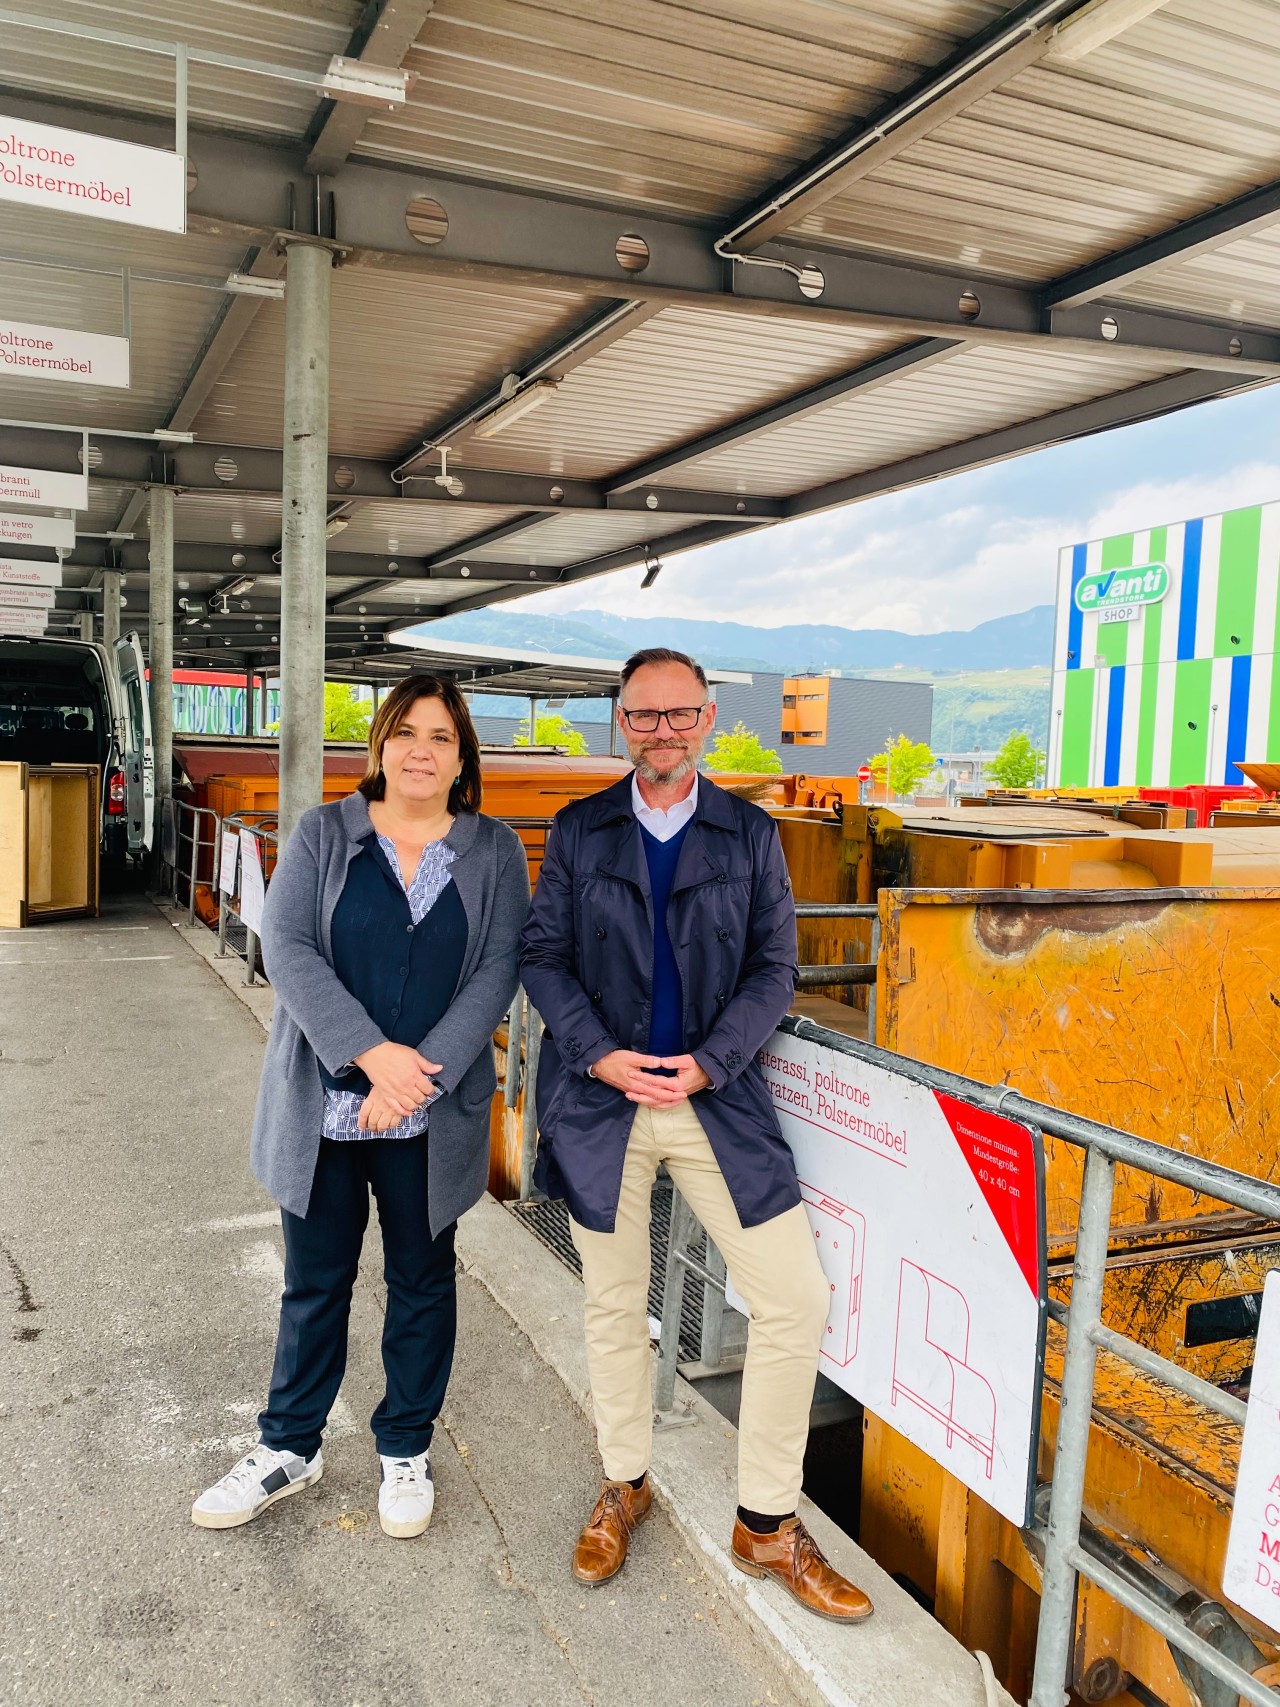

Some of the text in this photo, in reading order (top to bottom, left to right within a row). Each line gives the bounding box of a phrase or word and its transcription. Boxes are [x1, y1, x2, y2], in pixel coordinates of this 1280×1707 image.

[0, 331, 53, 351] oltrone
[0, 529, 32, 540] kungen
[1080, 568, 1163, 602] avanti
[1096, 593, 1145, 606] TRENDSTORE
[1104, 608, 1133, 621] SHOP
[814, 1070, 870, 1107] poltrone
[816, 1093, 907, 1154] Polstermöbel
[956, 1121, 1020, 1158] Dimensione minima:
[973, 1144, 1020, 1175] Mindestgröße:
[978, 1168, 1020, 1198] 40 x 40 cm
